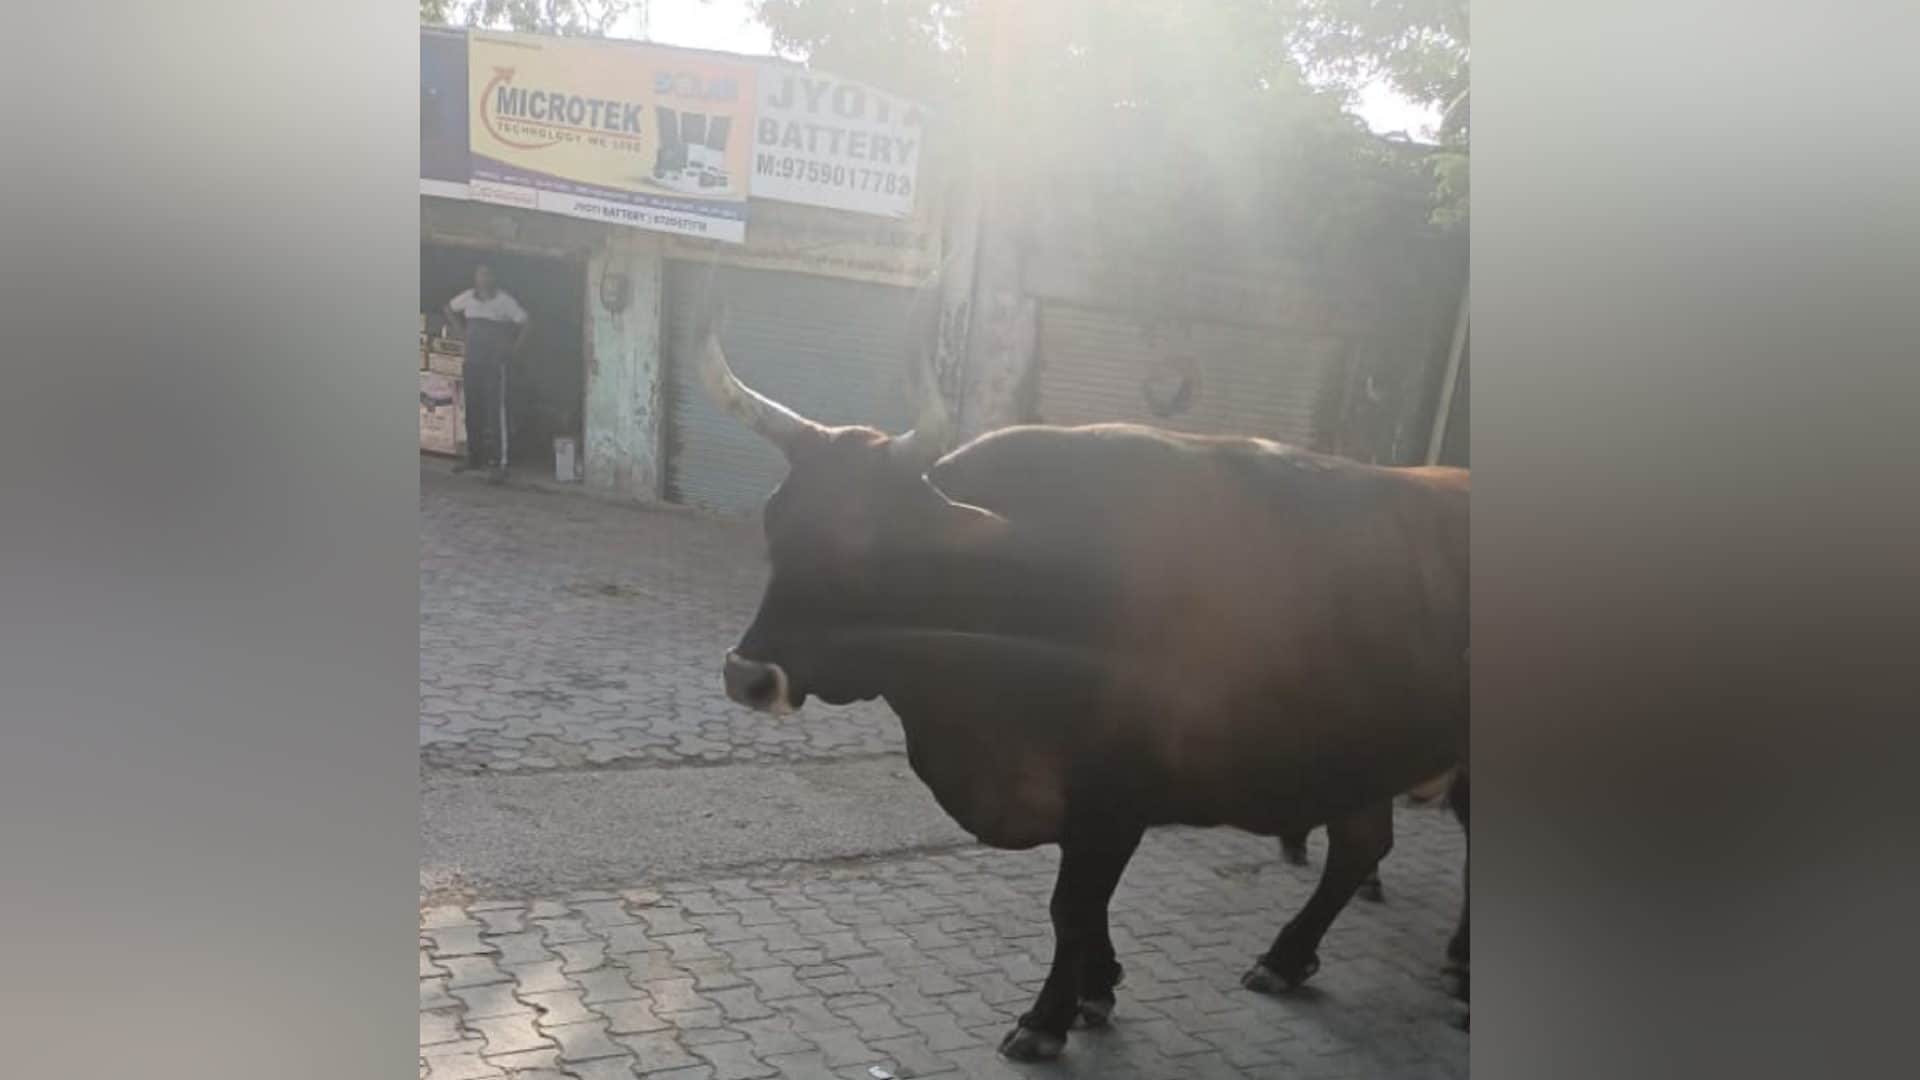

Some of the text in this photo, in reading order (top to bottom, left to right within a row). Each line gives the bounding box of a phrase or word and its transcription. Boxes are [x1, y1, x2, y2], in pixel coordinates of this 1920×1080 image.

[653, 72, 739, 102] SOL
[496, 86, 643, 134] MICROTEK
[496, 122, 582, 144] TECHNOLOGY
[587, 135, 609, 148] WE
[757, 116, 917, 165] BATTERY
[603, 206, 647, 223] BATTERY
